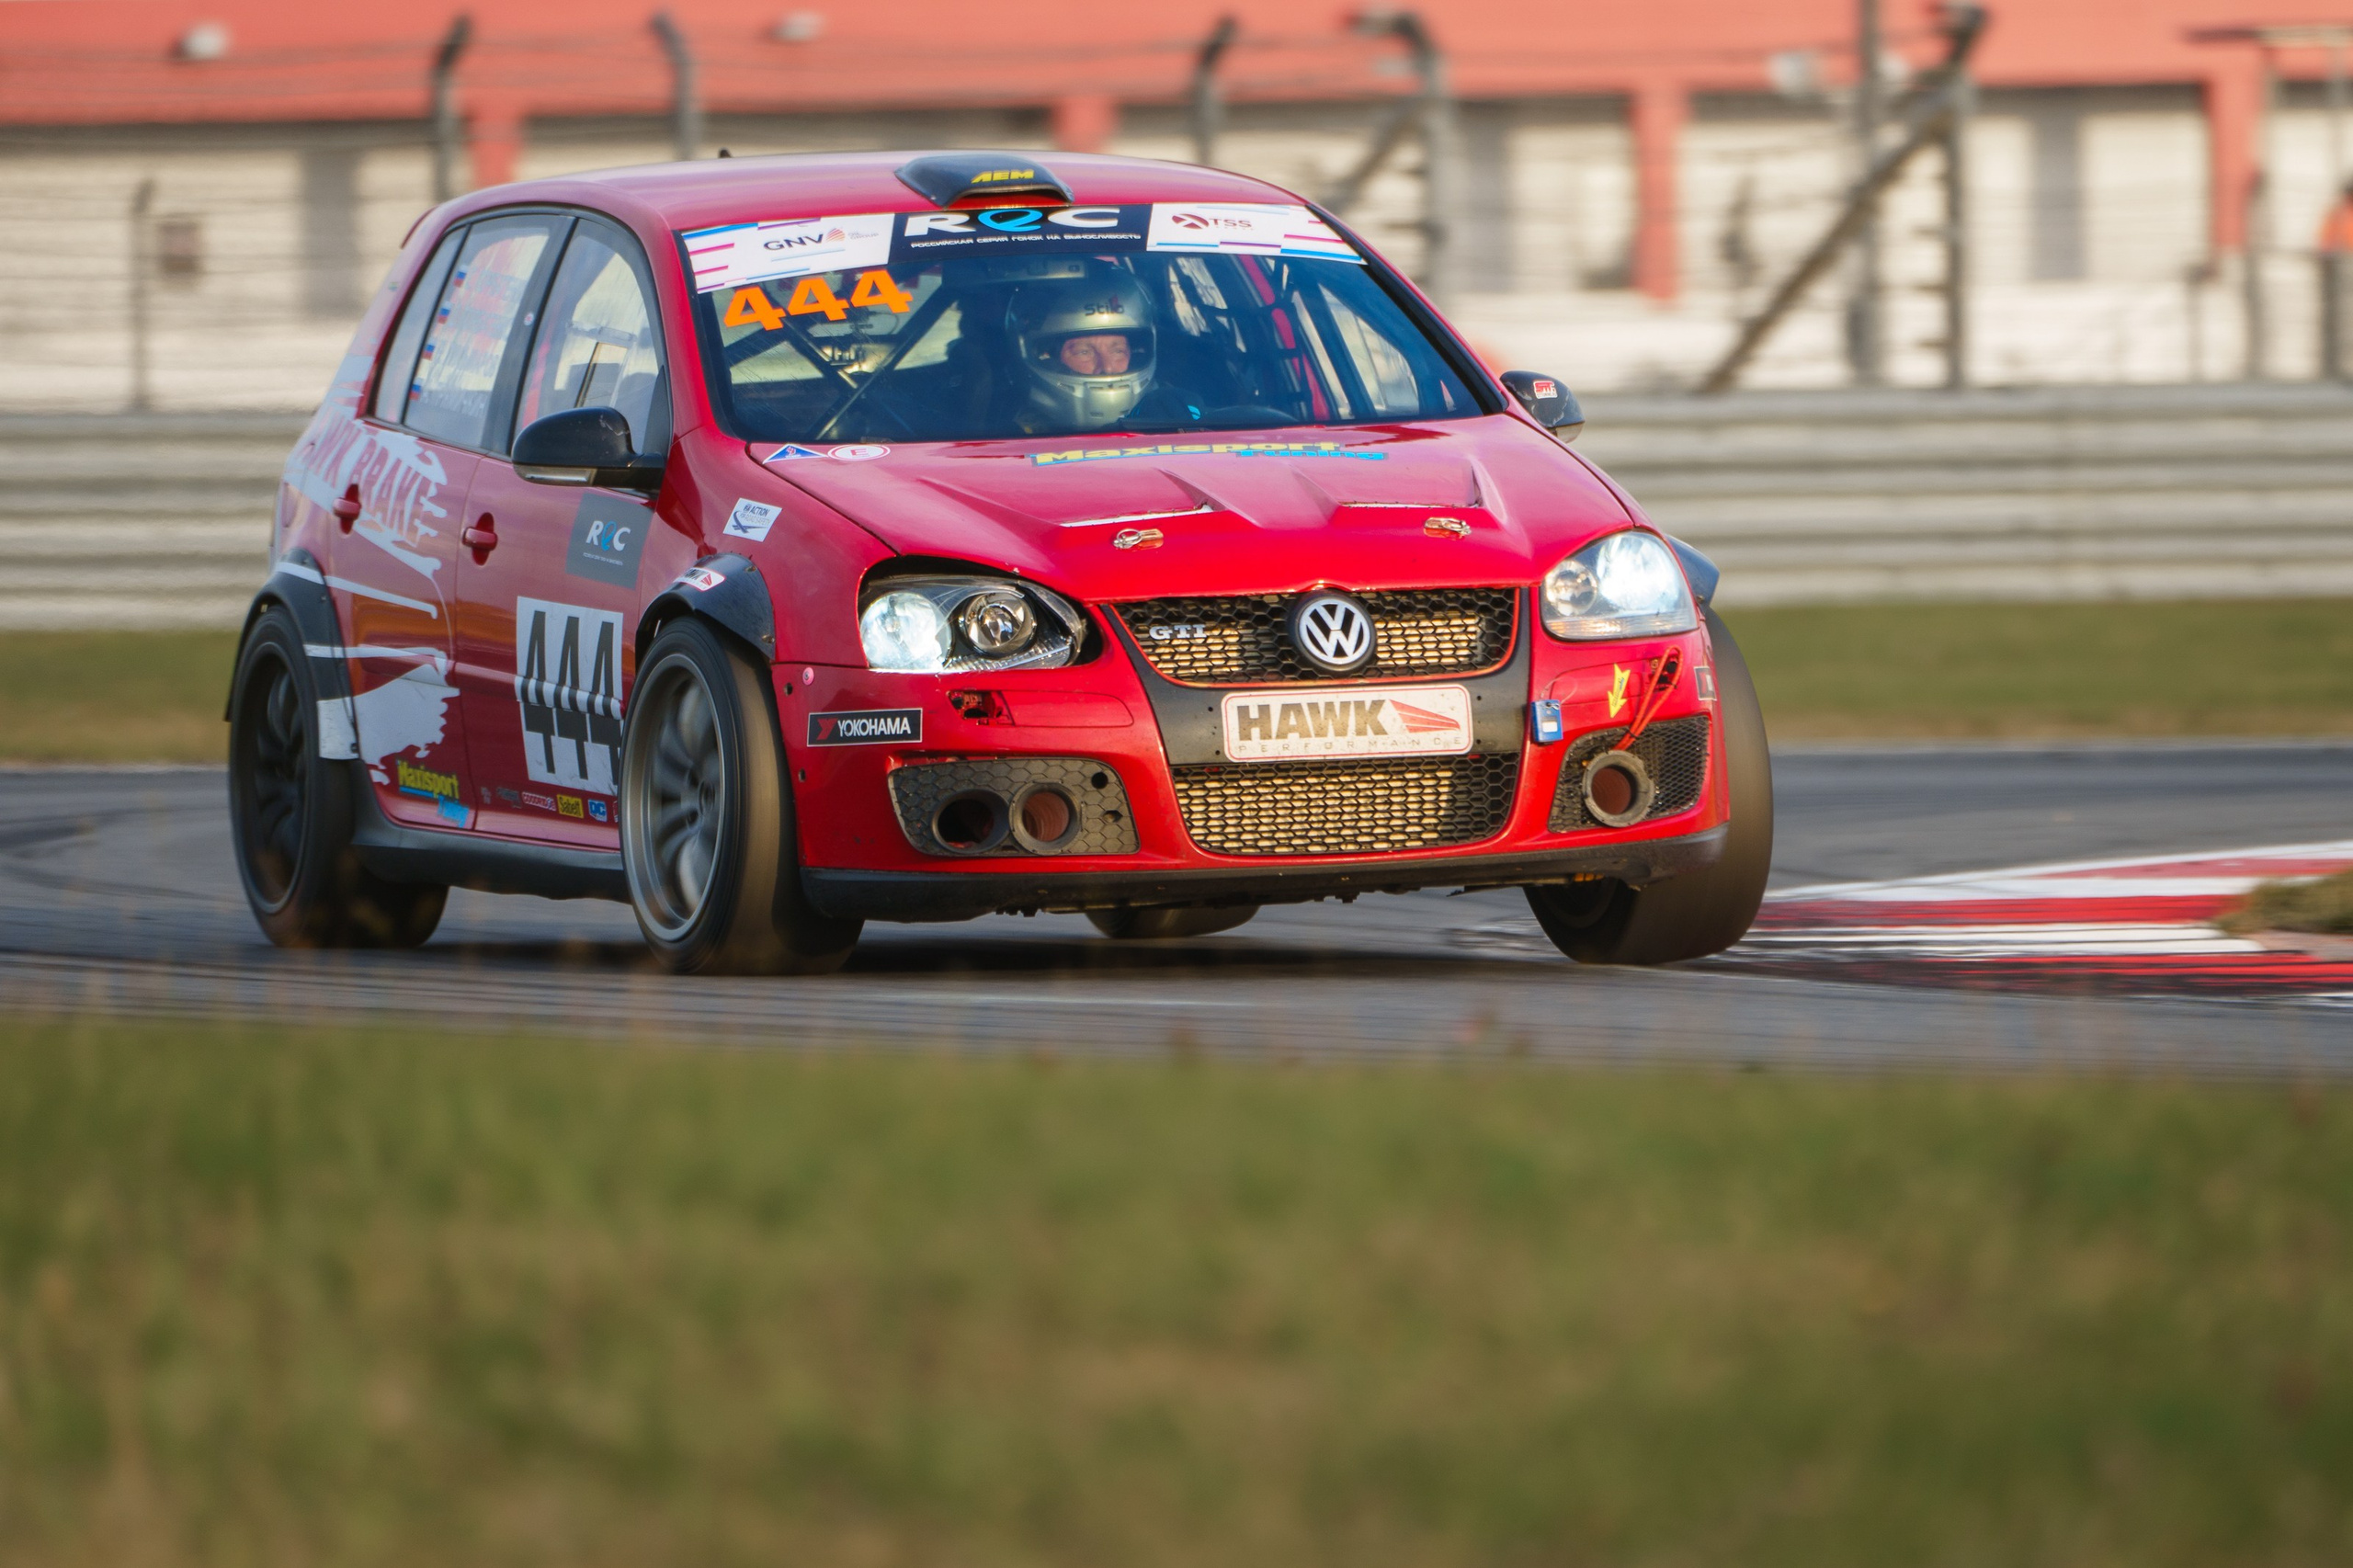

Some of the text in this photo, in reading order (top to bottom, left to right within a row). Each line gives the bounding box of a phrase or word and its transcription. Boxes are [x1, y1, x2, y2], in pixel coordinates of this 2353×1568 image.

[972, 169, 1034, 184] AEM
[1209, 218, 1252, 228] TSS
[764, 233, 824, 251] GNV
[723, 269, 914, 331] 444
[1037, 442, 1340, 464] Maxisport
[1230, 449, 1384, 460] Tuning
[1150, 624, 1206, 641] GTI
[520, 610, 622, 787] 444
[837, 717, 911, 737] YOKOHAMA
[1237, 699, 1389, 741] HAWK
[1239, 735, 1462, 754] PERFORMANCE
